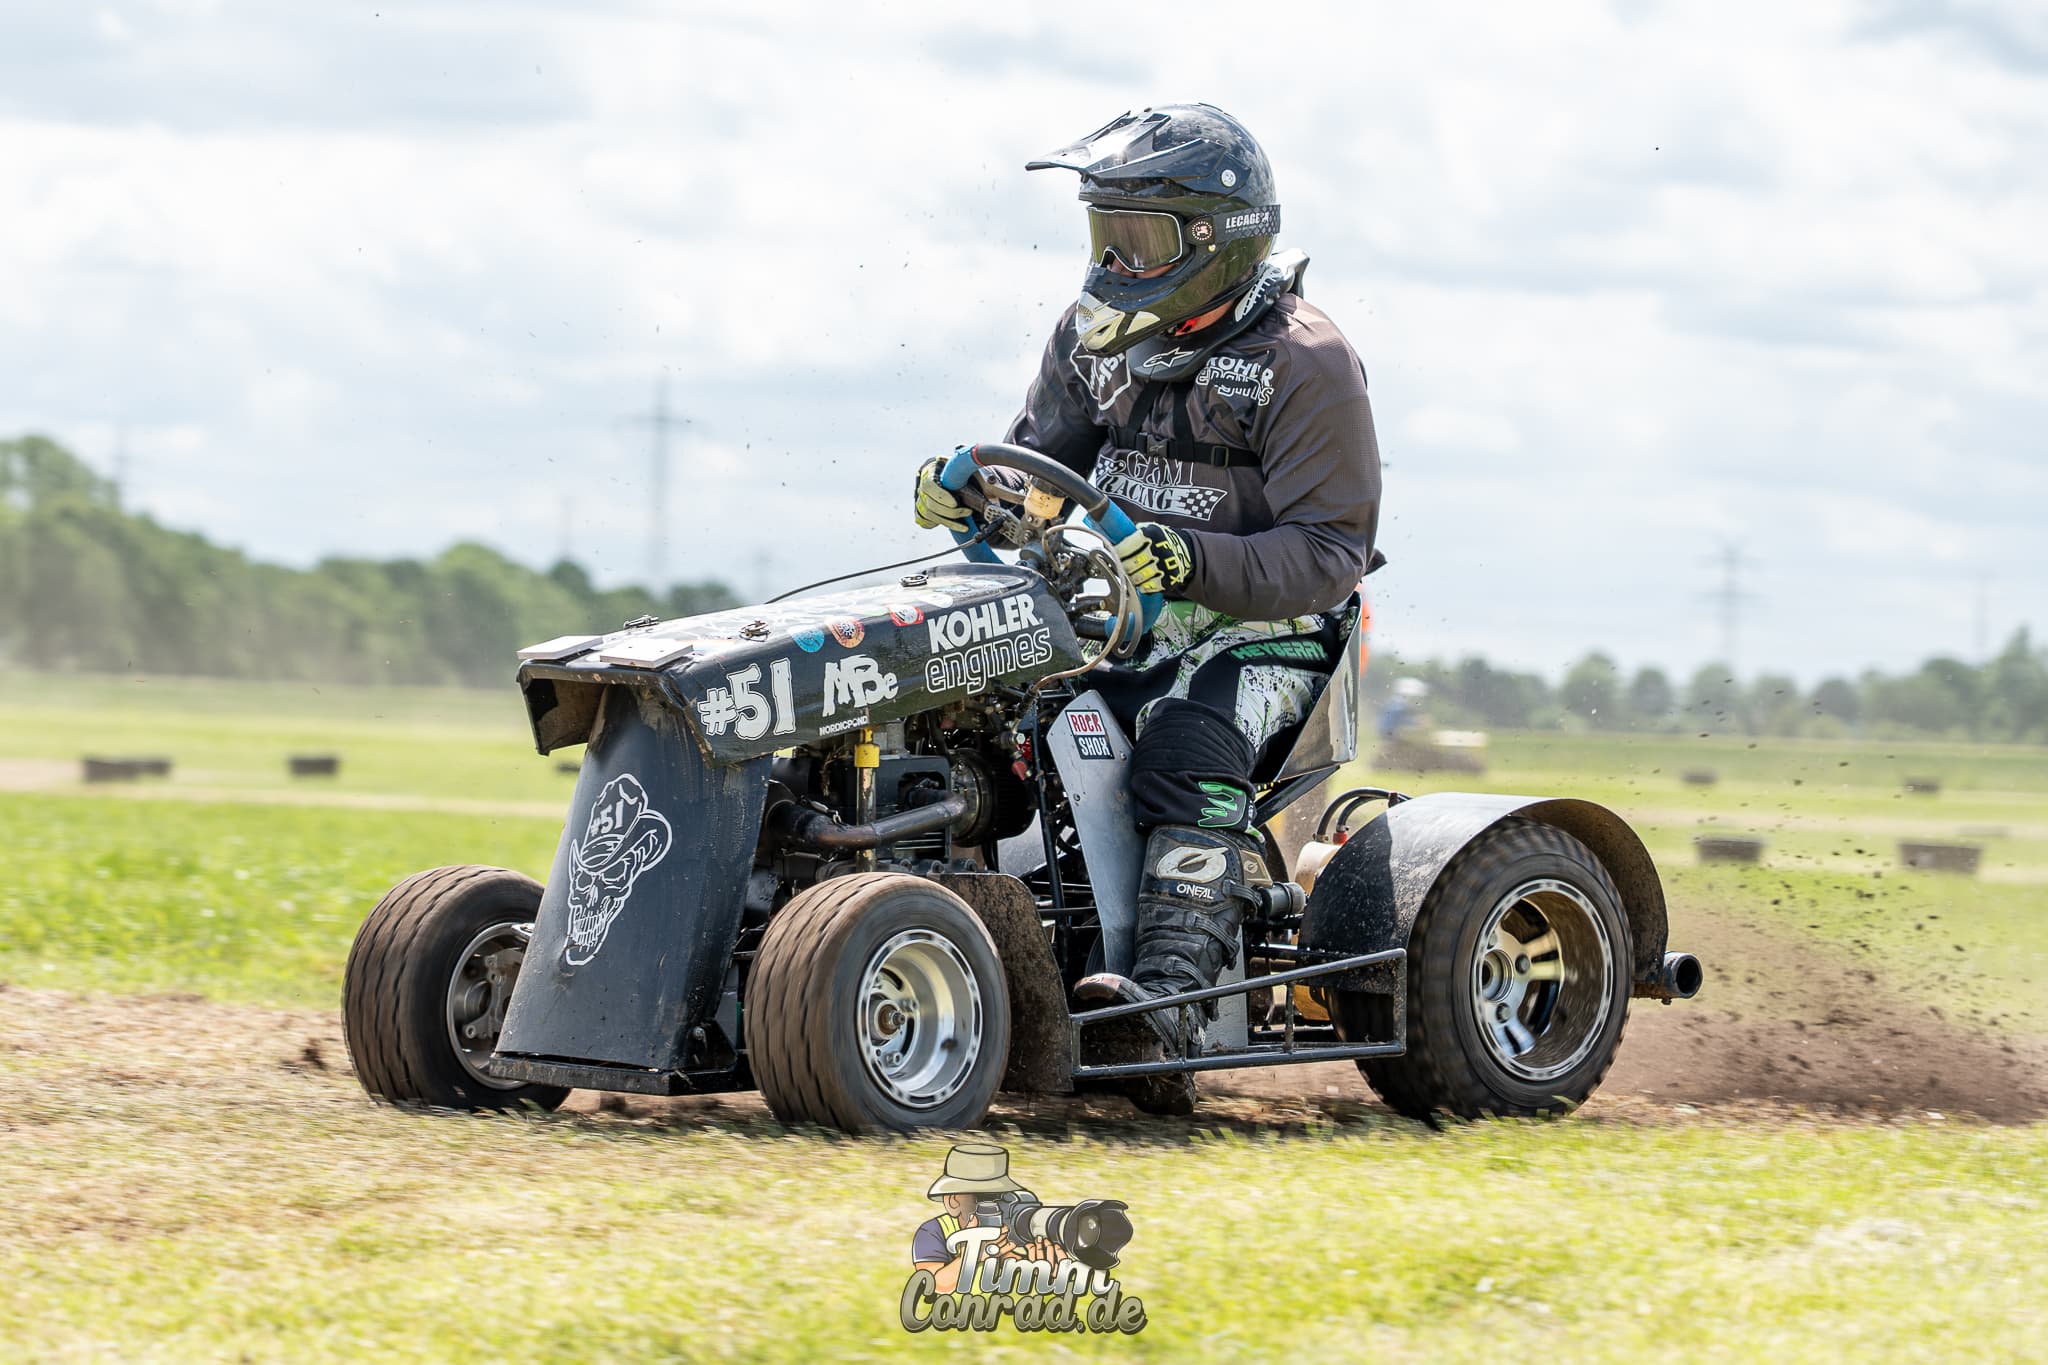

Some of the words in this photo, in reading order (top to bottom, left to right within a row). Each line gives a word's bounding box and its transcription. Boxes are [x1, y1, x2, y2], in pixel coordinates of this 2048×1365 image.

[925, 627, 1053, 695] engines
[697, 657, 796, 740] #51
[1070, 713, 1103, 732] ROCK
[590, 799, 625, 837] #51
